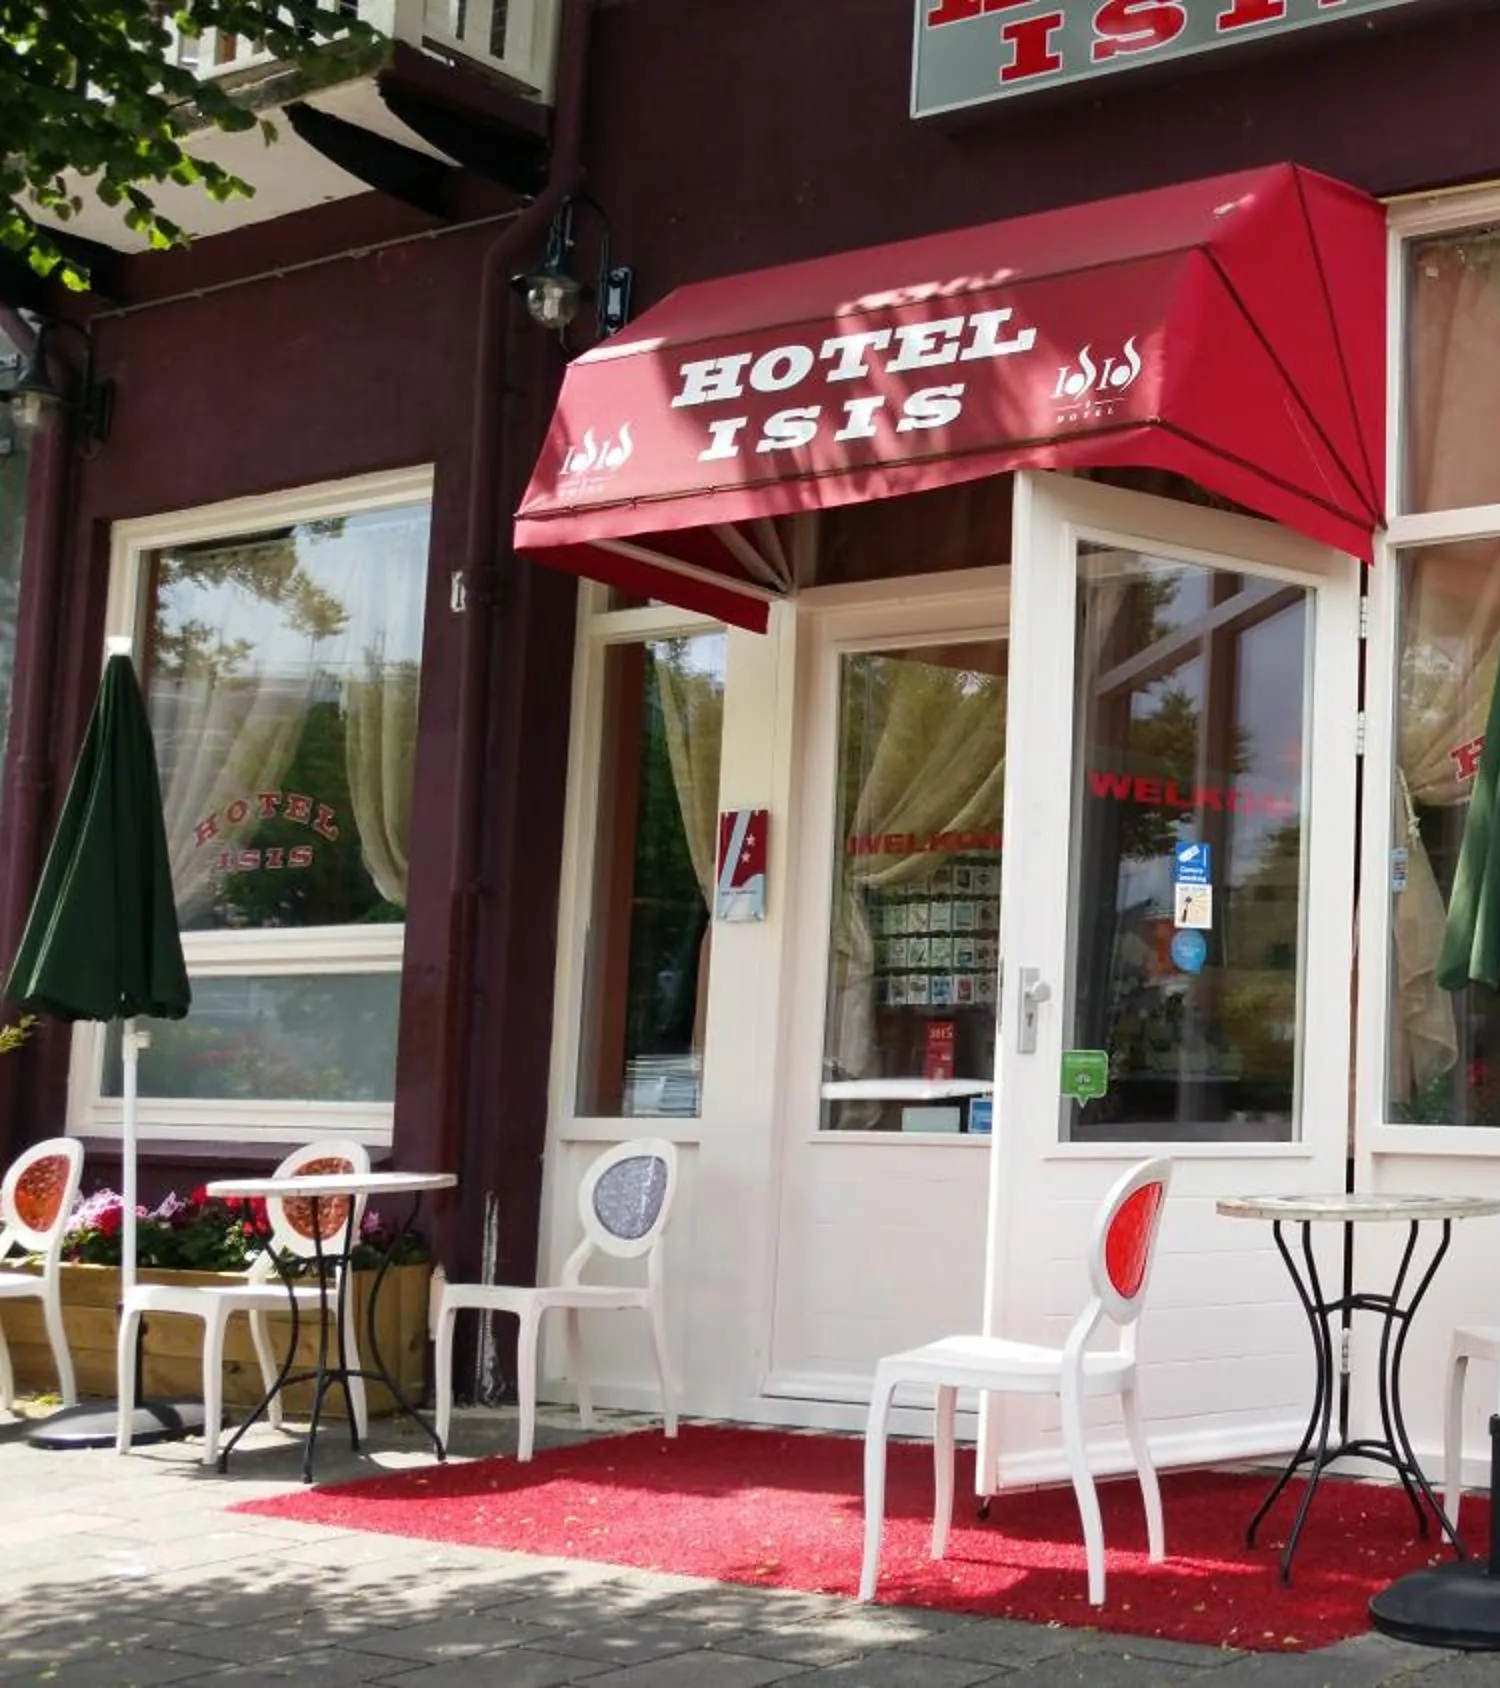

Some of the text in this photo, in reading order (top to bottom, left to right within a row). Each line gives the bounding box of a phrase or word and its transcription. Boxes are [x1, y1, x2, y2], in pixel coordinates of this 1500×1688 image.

[1000, 0, 1346, 82] IS
[670, 307, 1037, 409] HOTEL
[697, 383, 965, 462] ISIS
[193, 789, 339, 847] HOTEL
[214, 846, 313, 871] ISIS
